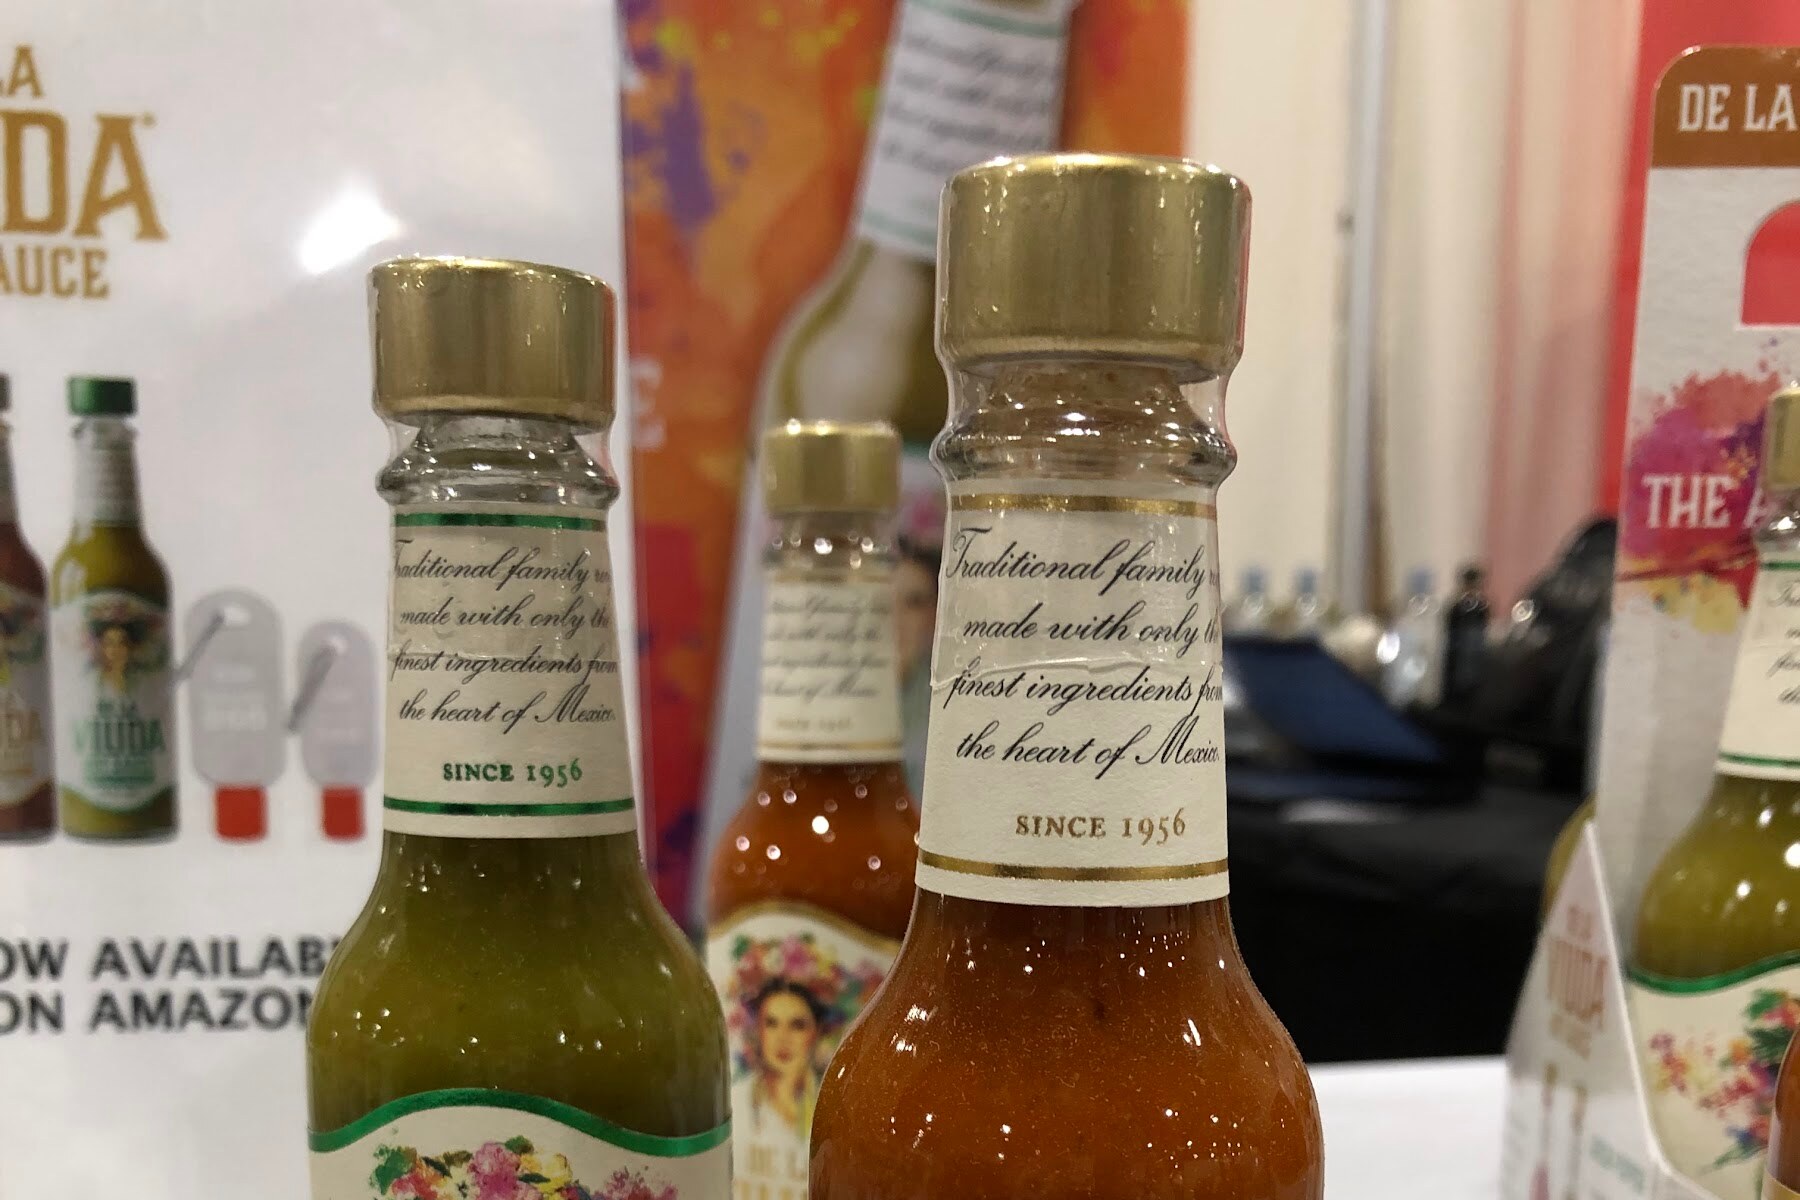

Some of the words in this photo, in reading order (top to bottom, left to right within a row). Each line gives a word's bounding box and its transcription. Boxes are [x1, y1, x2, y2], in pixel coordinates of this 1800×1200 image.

[0, 45, 44, 98] A
[1678, 83, 1731, 133] DE
[1744, 83, 1799, 133] LA
[1643, 473, 1732, 529] THE
[497, 547, 592, 592] family
[946, 527, 1129, 582] Traditional
[1098, 540, 1206, 600] family
[400, 596, 454, 626] made
[459, 593, 535, 626] with
[530, 596, 585, 640] only
[963, 602, 1043, 638] made
[1049, 600, 1147, 642] with
[1138, 601, 1199, 660] only
[390, 638, 445, 682] finest
[444, 645, 583, 685] ingredients
[943, 656, 1027, 710] finest
[1026, 665, 1193, 717] ingredients
[399, 688, 427, 721] the
[430, 688, 502, 722] heart
[501, 691, 547, 735] of
[443, 762, 515, 783] SINCE
[526, 757, 583, 788] 1956
[956, 719, 1000, 760] the
[1001, 721, 1096, 765] heart
[1094, 723, 1152, 780] of
[1016, 813, 1107, 839] SINCE
[1121, 808, 1187, 846] 1956
[91, 935, 343, 981] AVAILAB
